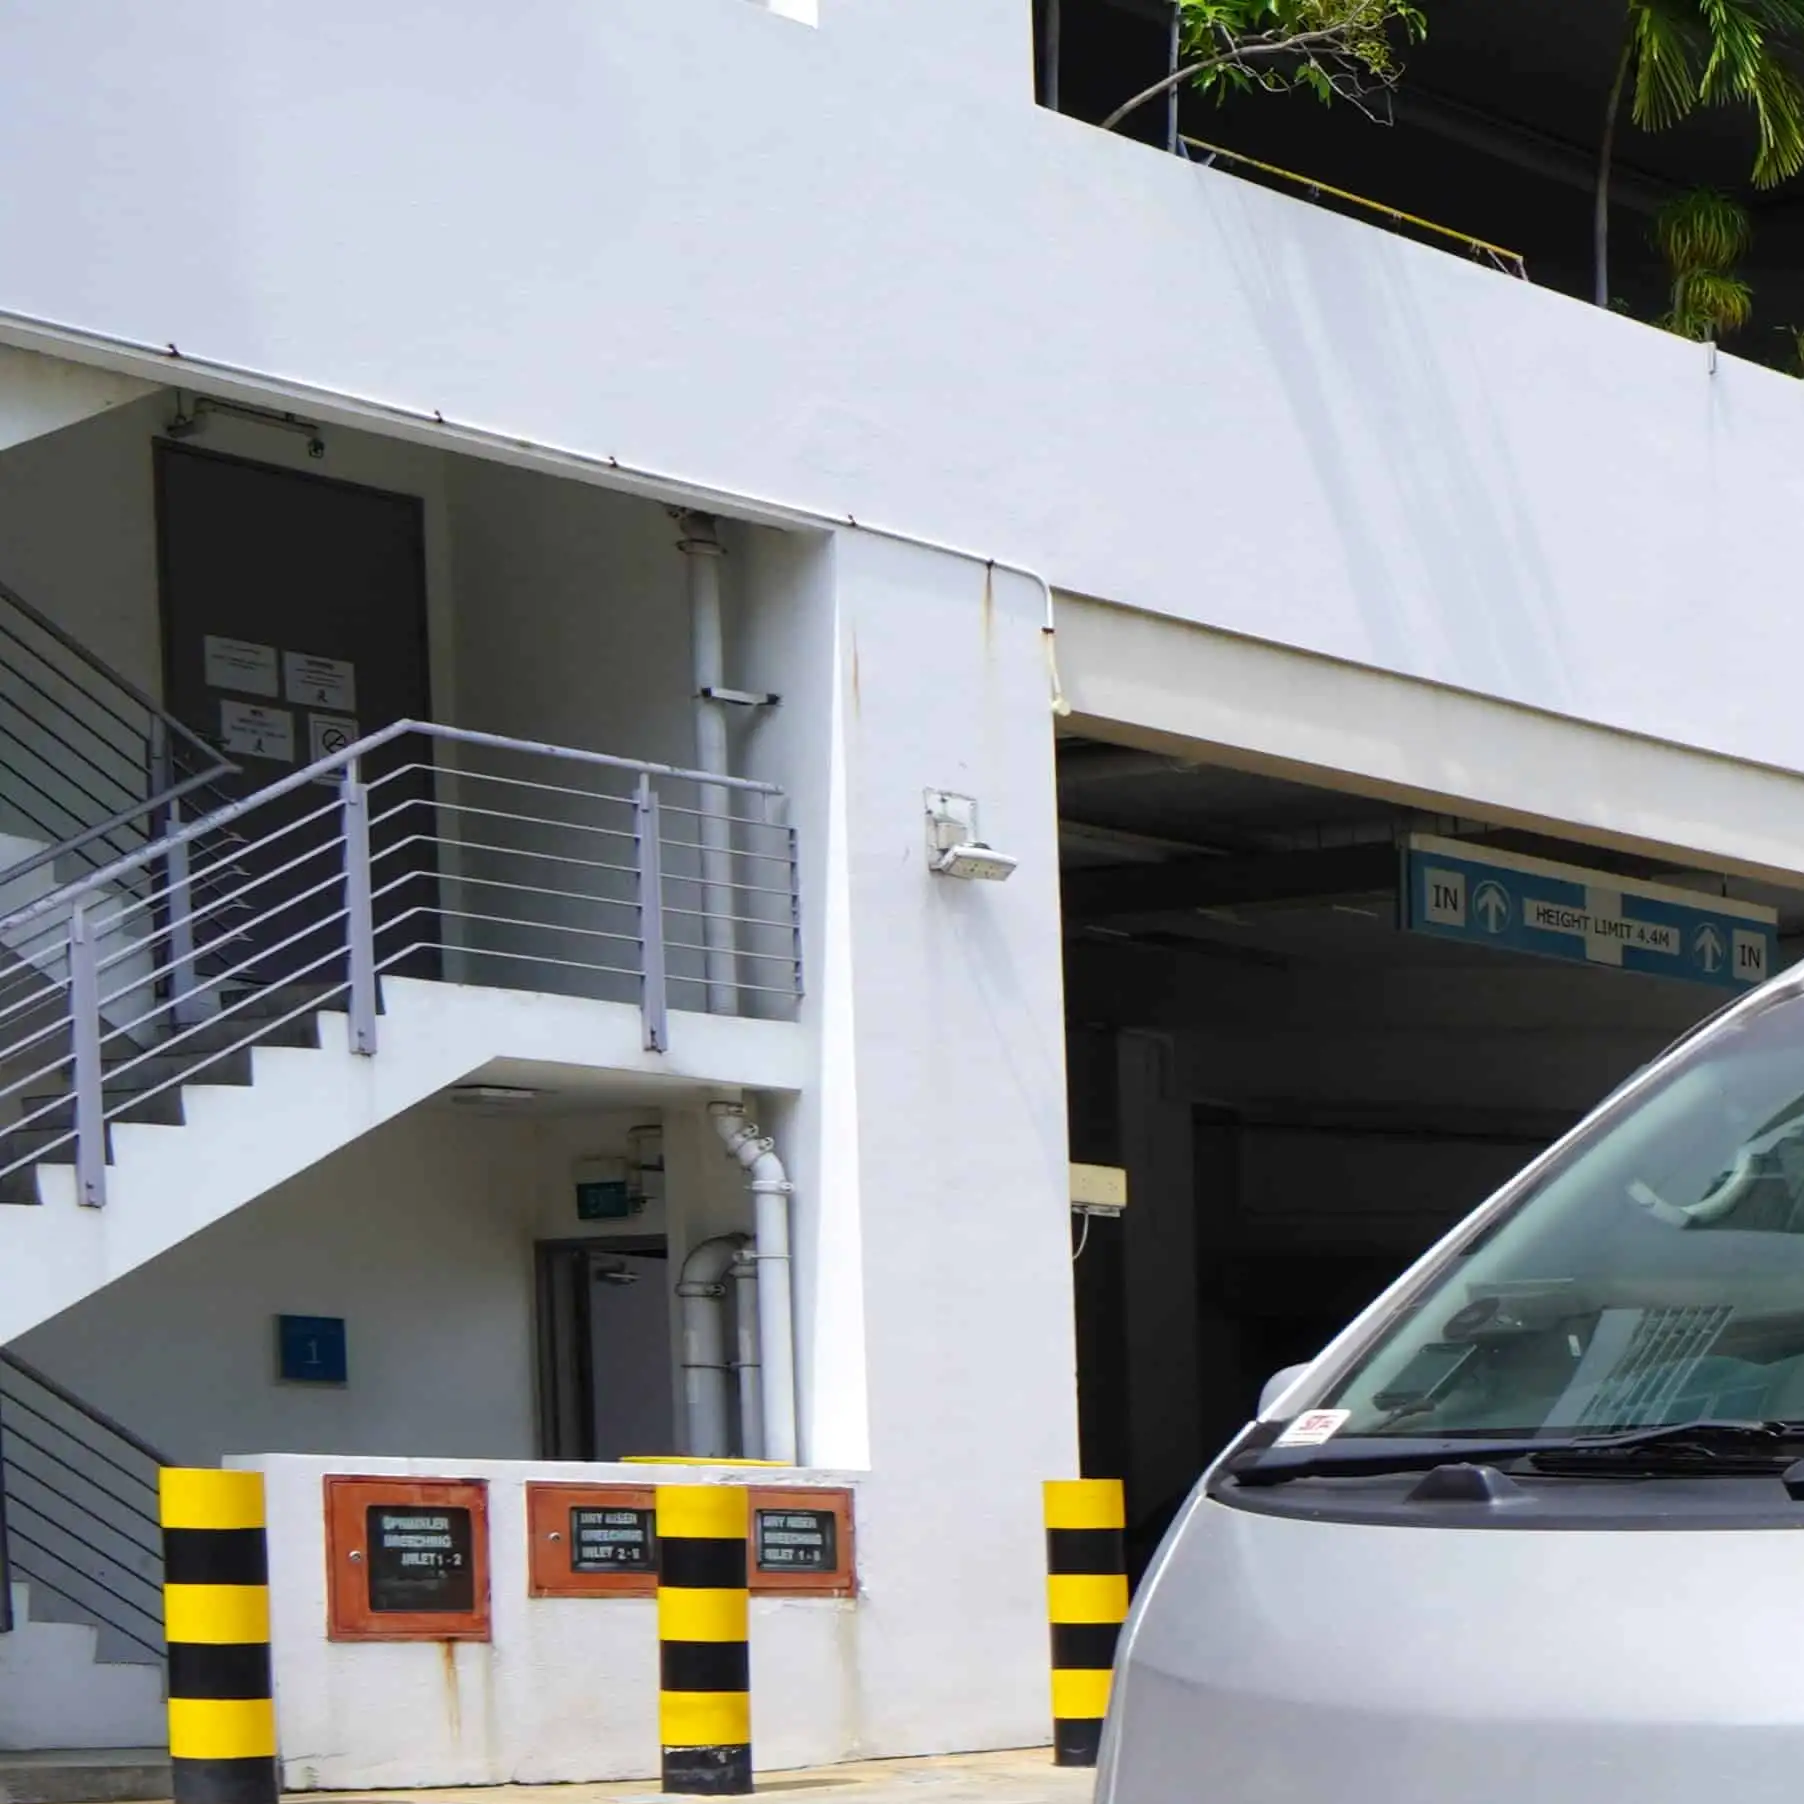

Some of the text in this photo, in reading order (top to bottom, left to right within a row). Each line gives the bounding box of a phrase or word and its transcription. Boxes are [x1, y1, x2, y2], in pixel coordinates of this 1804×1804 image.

[1433, 885, 1458, 911] IN
[1536, 904, 1670, 947] HEIGHT LIMIT 4.4M
[1738, 944, 1761, 969] IN
[301, 1339, 323, 1364] 1
